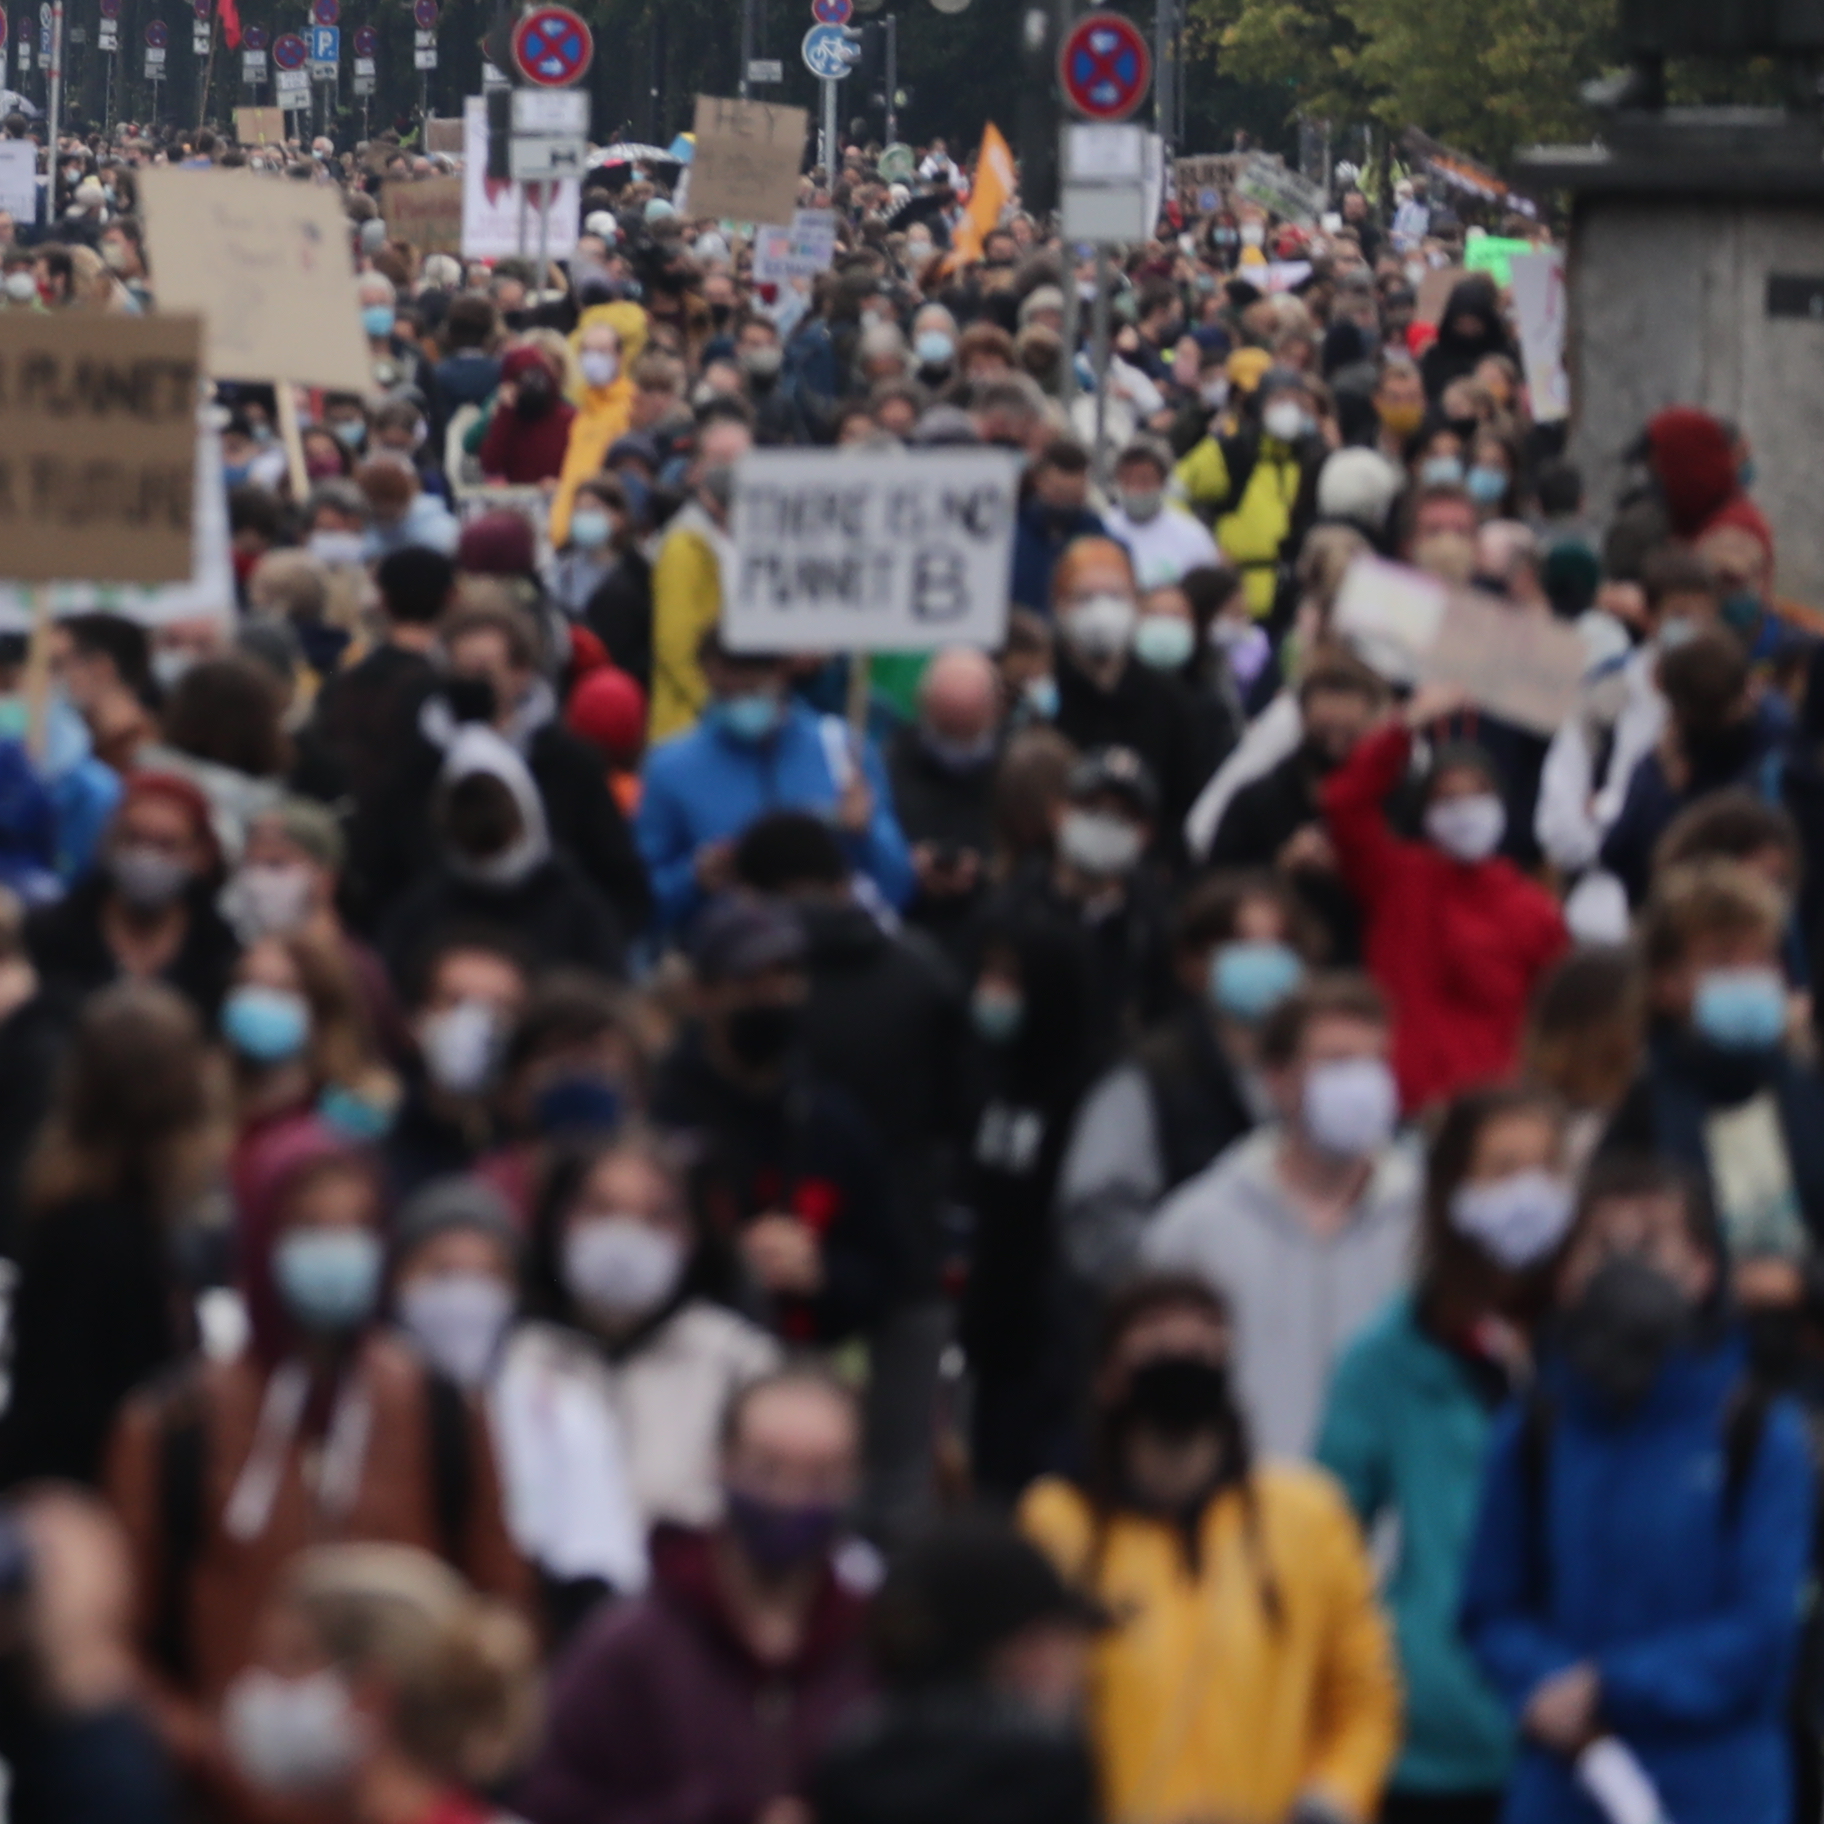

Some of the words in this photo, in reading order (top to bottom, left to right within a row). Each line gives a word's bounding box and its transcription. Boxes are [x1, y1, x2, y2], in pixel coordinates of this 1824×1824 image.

[318, 30, 333, 58] P
[740, 482, 870, 542] THERE
[939, 479, 1006, 545] NO
[904, 540, 971, 623] B
